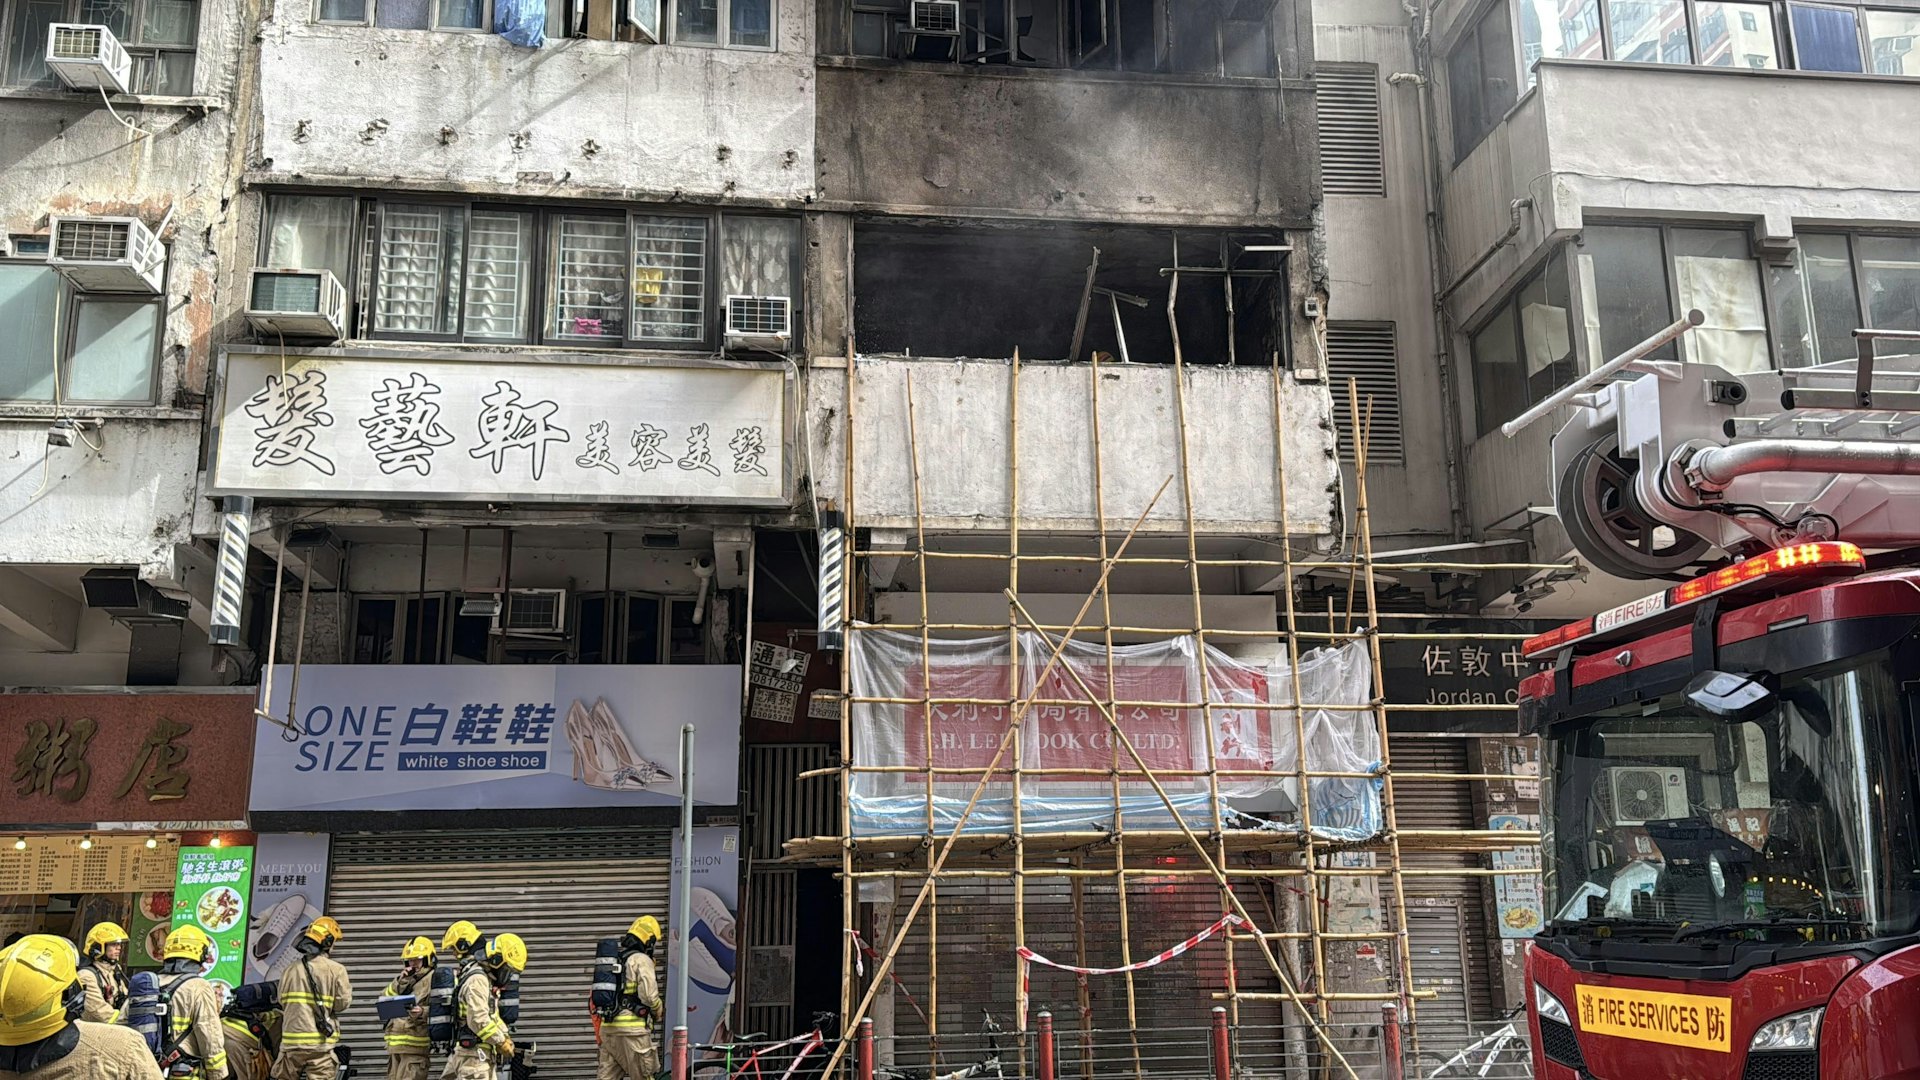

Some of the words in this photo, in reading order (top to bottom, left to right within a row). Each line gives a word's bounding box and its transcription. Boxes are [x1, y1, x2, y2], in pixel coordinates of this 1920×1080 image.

[576, 421, 769, 477] 美容美髮
[1614, 601, 1644, 624] FIRE
[1421, 644, 1553, 677] 佐敦中
[1426, 688, 1496, 705] Jordan
[305, 706, 397, 736] ONE
[400, 703, 556, 745] 白鞋鞋
[1133, 733, 1180, 750] LTD.
[295, 741, 389, 772] SIZE
[405, 755, 449, 768] white
[457, 755, 496, 768] shoe
[501, 754, 540, 768] shoe
[260, 863, 294, 873] MEET
[297, 863, 321, 873] YOU
[674, 856, 721, 866] FHION
[258, 875, 307, 886] 遇見好鞋
[1582, 994, 1594, 1025] 消
[1598, 998, 1626, 1027] FIRE
[1629, 1001, 1700, 1036] SERVICES
[1705, 1006, 1725, 1042] 防
